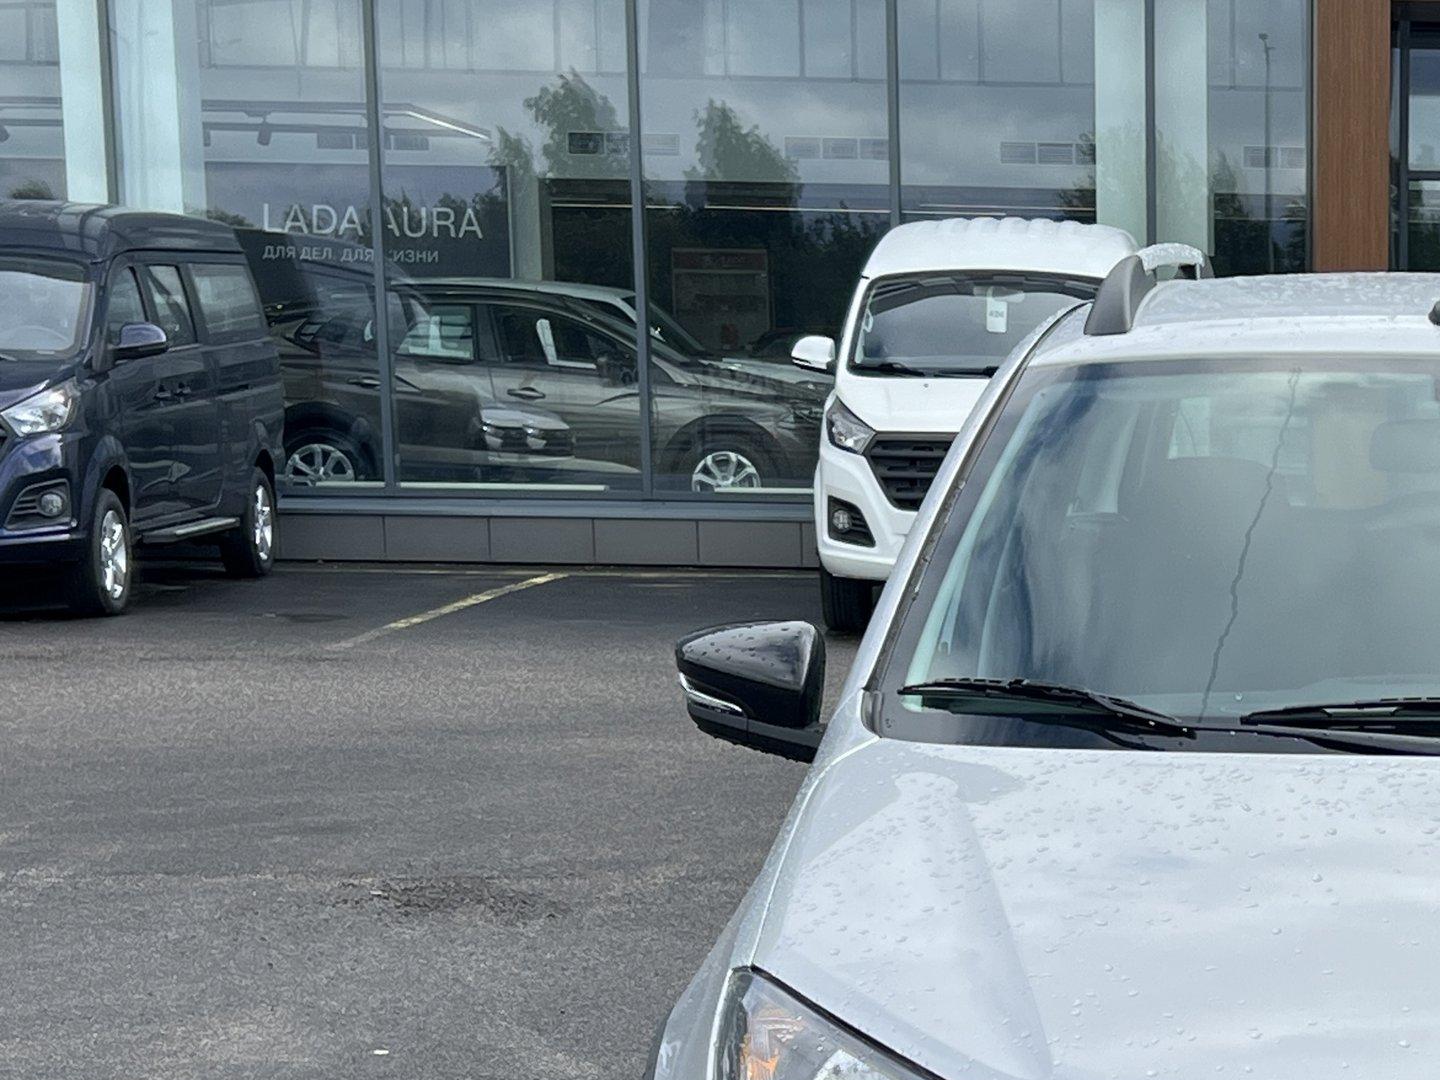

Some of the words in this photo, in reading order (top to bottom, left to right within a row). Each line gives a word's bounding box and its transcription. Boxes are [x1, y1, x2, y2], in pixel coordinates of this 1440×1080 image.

[262, 202, 364, 236] LADA
[262, 246, 296, 260] ДЛЯ
[340, 248, 374, 263] ДЛЯ
[388, 250, 439, 263] ИЗНИ
